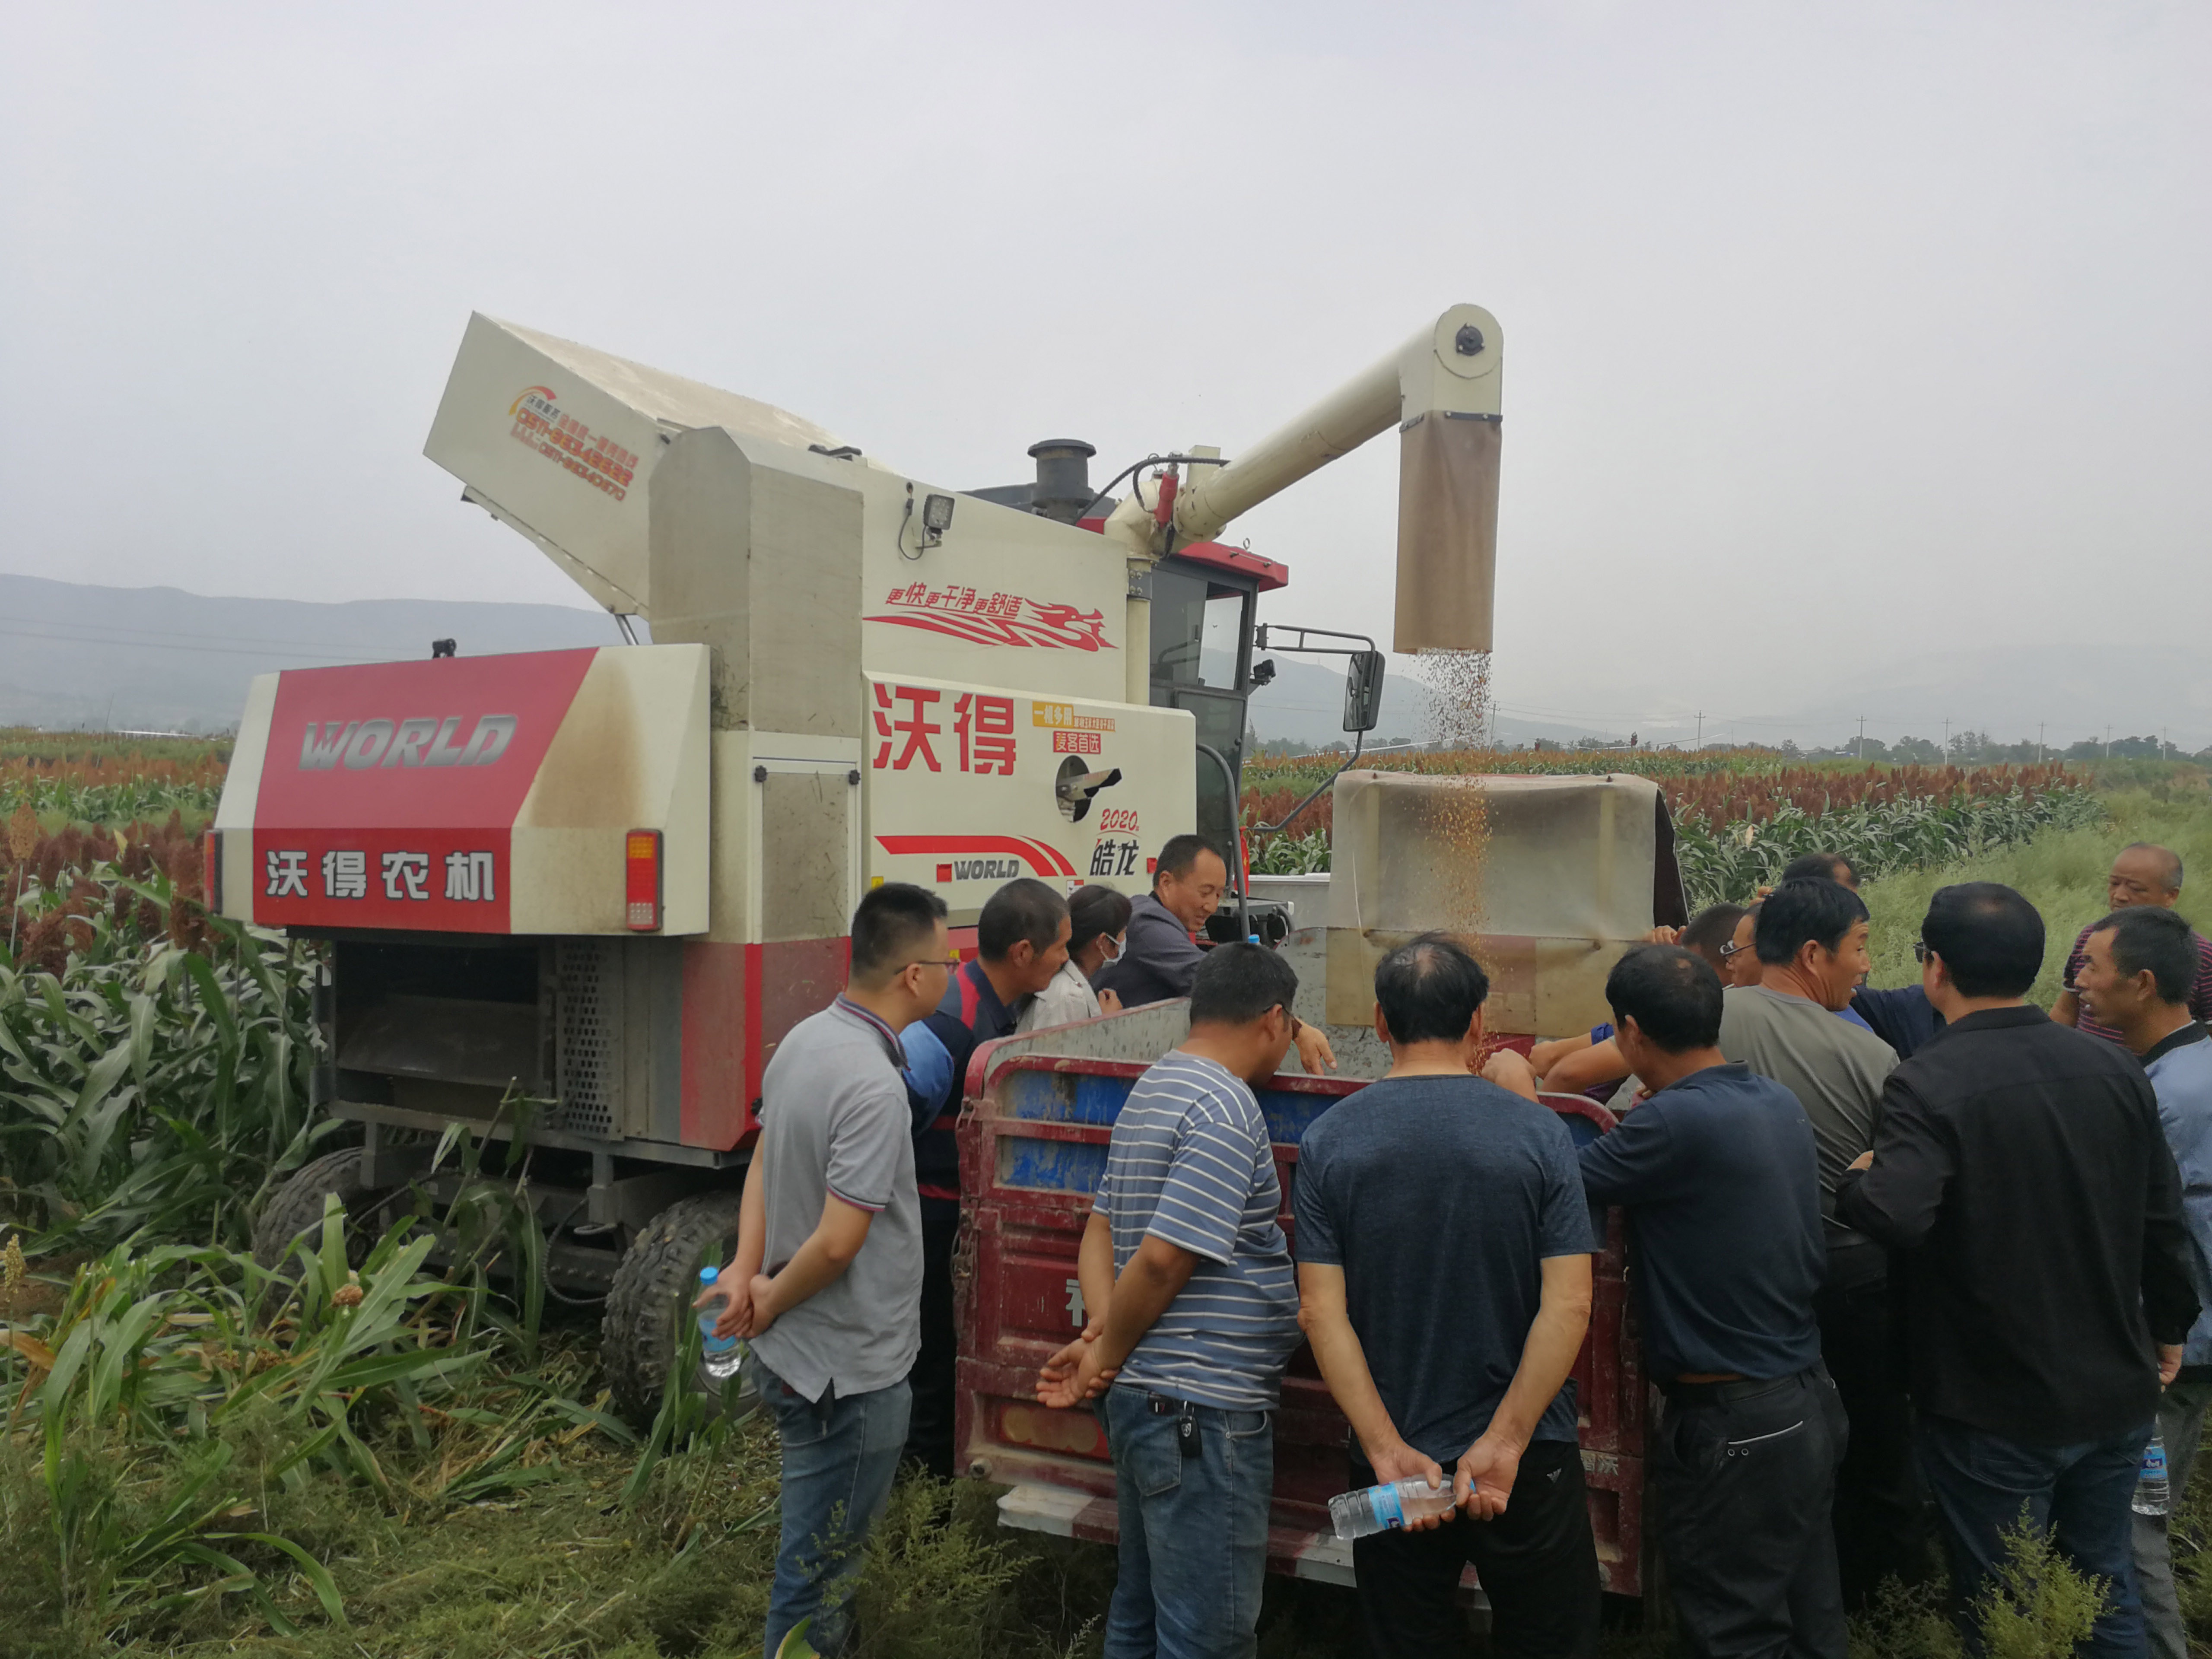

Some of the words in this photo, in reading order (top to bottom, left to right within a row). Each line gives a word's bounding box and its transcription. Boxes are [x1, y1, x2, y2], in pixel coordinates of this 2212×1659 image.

[885, 582, 1023, 618] 更快更干净更舒适
[298, 713, 518, 771] WORLD
[873, 683, 1016, 775] 沃得
[1055, 733, 1099, 753] 麦客首选
[265, 850, 495, 901] 沃得农机
[954, 860, 1019, 880] WORLD
